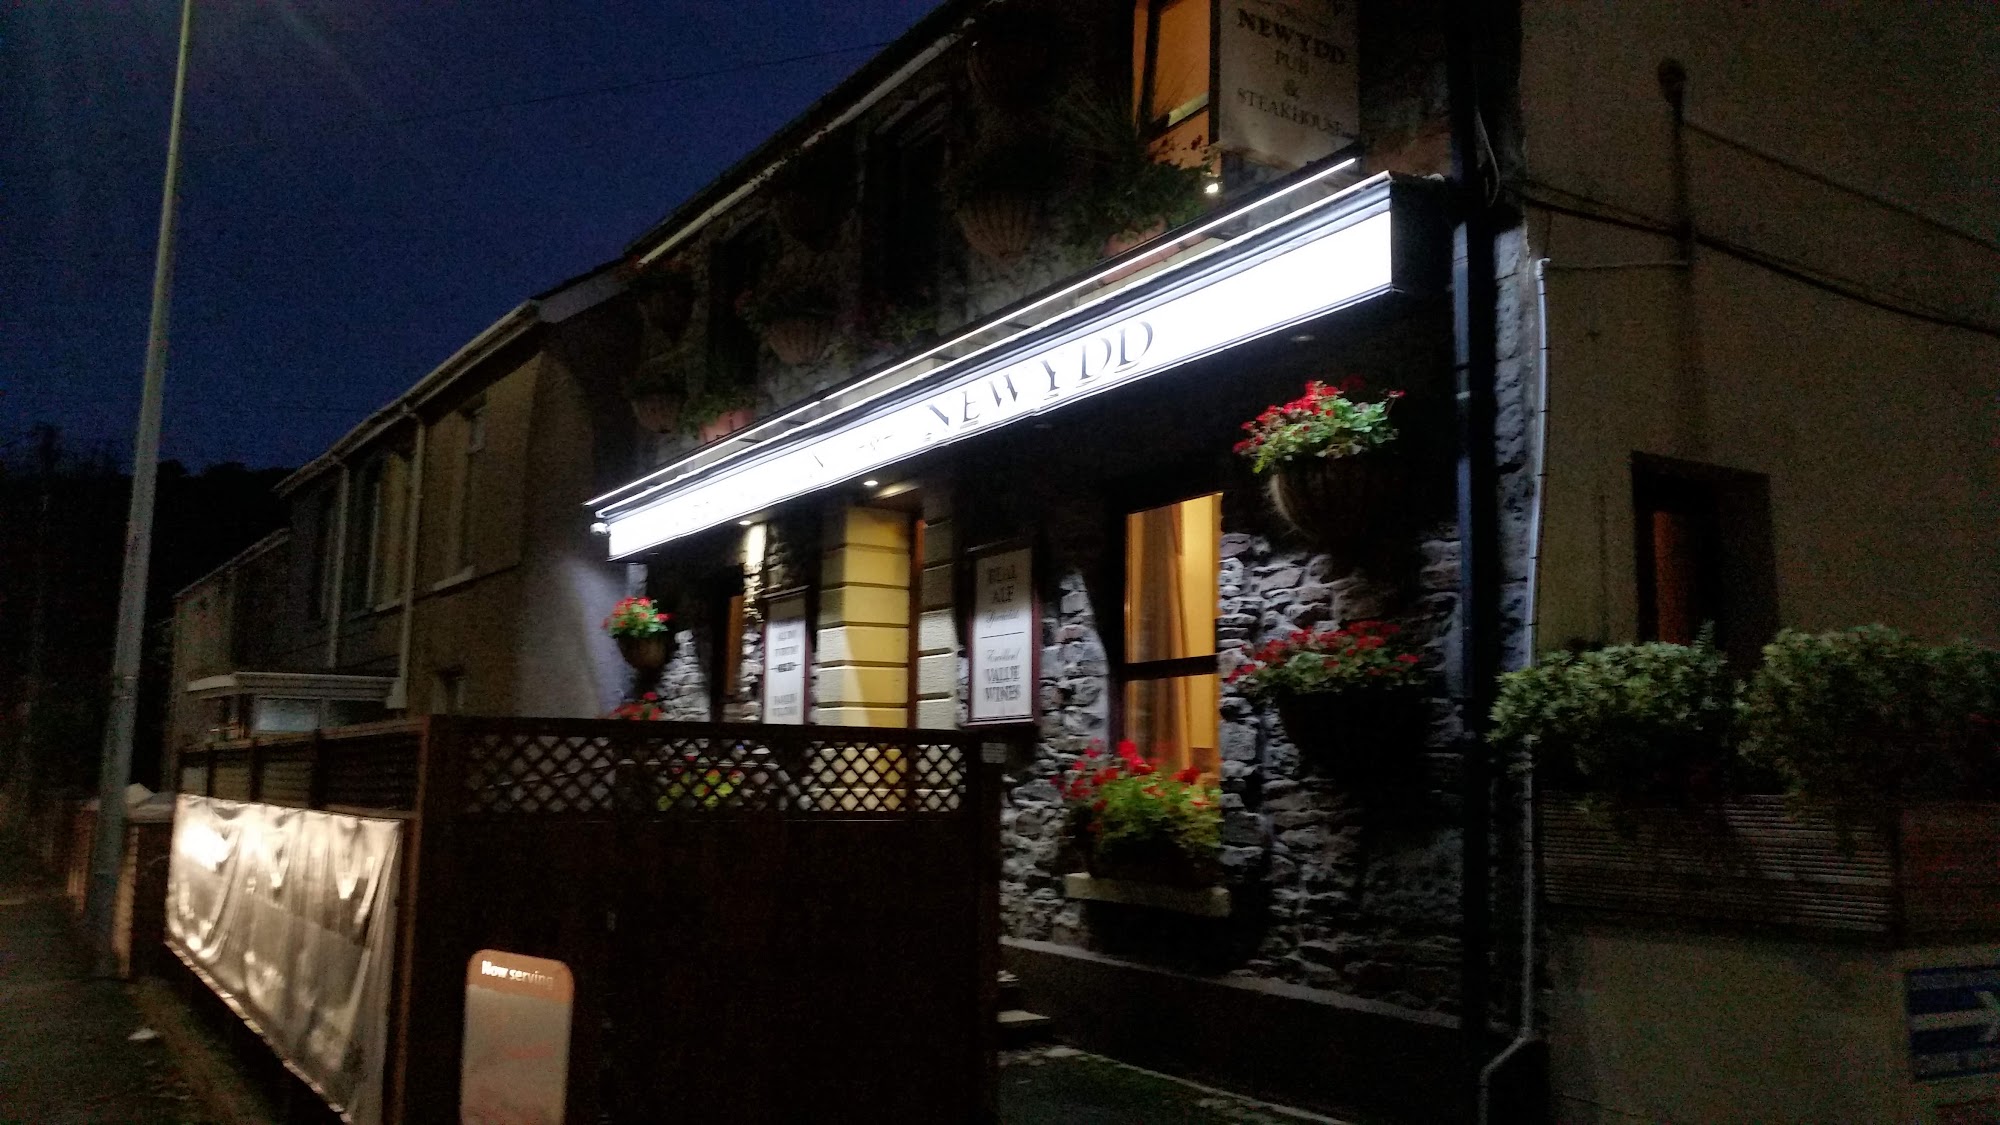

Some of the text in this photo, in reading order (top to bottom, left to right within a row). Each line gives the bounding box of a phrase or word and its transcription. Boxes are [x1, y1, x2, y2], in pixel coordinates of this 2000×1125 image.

[1237, 8, 1345, 64] NEWYDD
[925, 321, 1154, 441] NEWYDD
[985, 684, 1022, 703] WINES
[481, 960, 554, 990] Now serving
